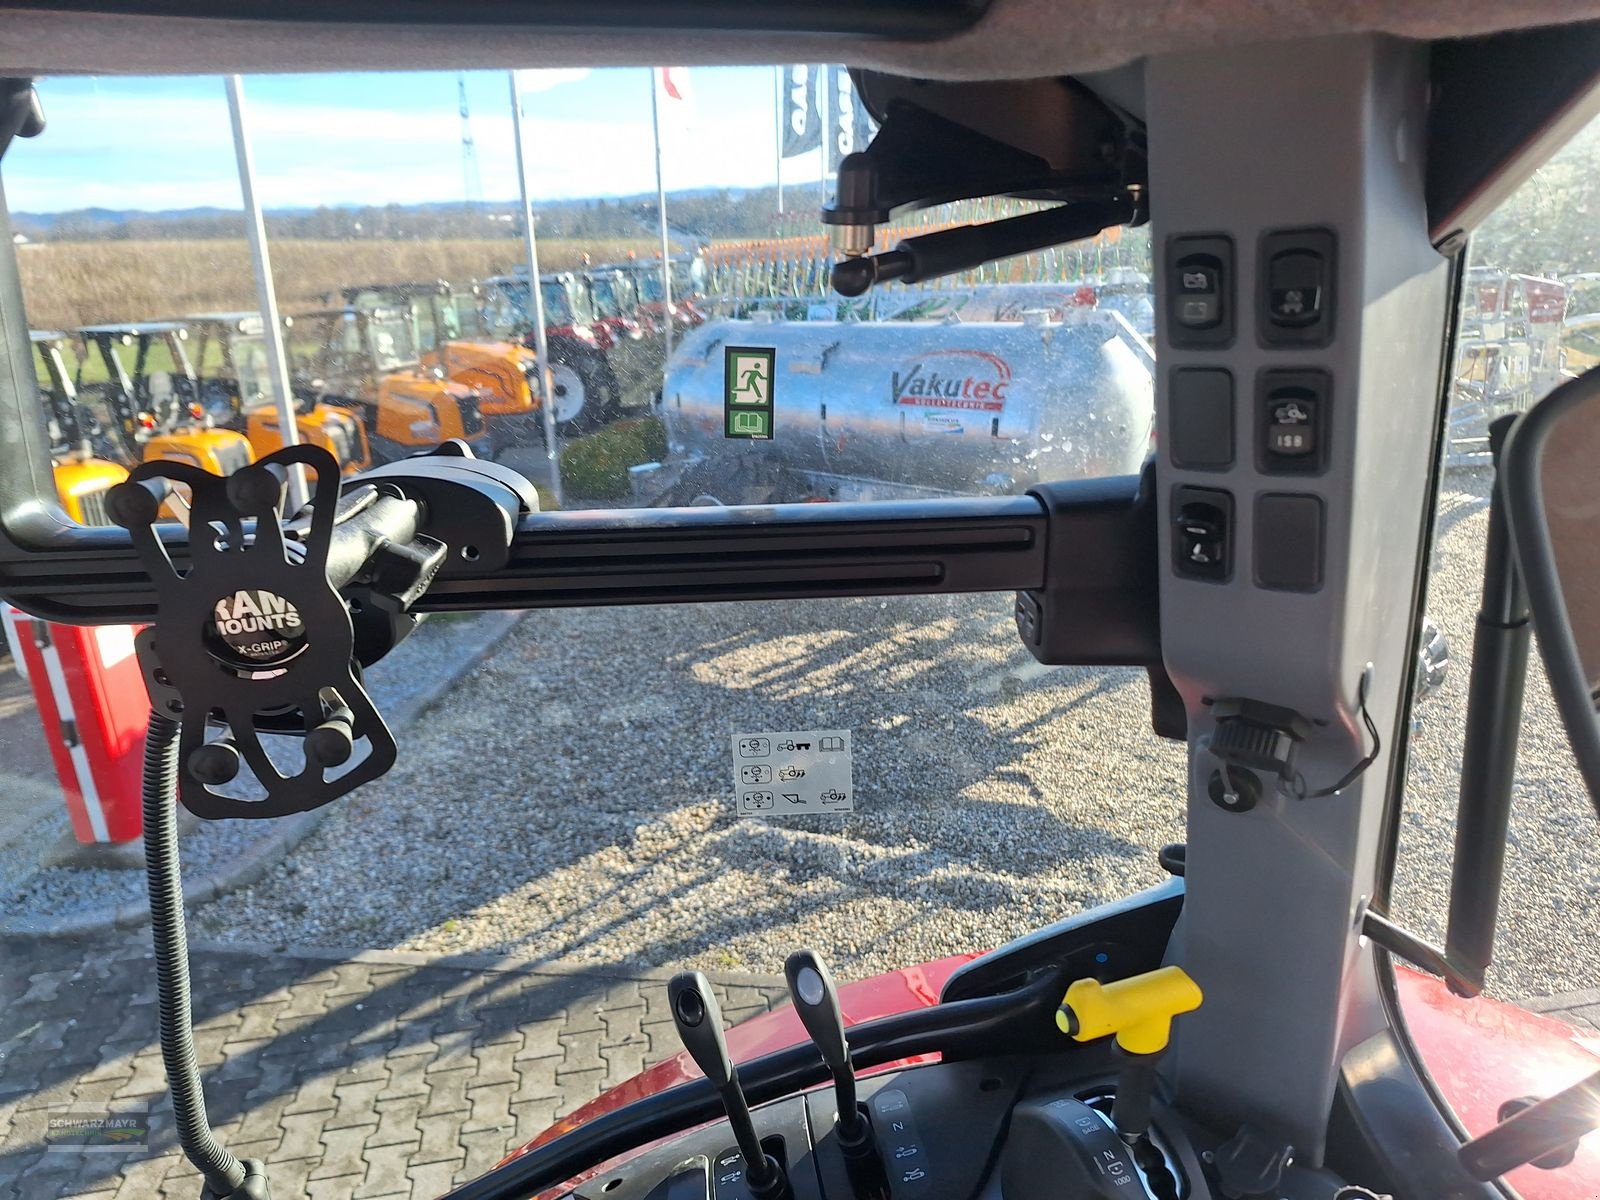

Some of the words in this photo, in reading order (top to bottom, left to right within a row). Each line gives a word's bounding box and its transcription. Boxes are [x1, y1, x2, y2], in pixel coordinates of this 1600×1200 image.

[892, 364, 1008, 404] Vakutec
[1103, 1149, 1116, 1161] N
[1113, 1174, 1132, 1187] 1000
